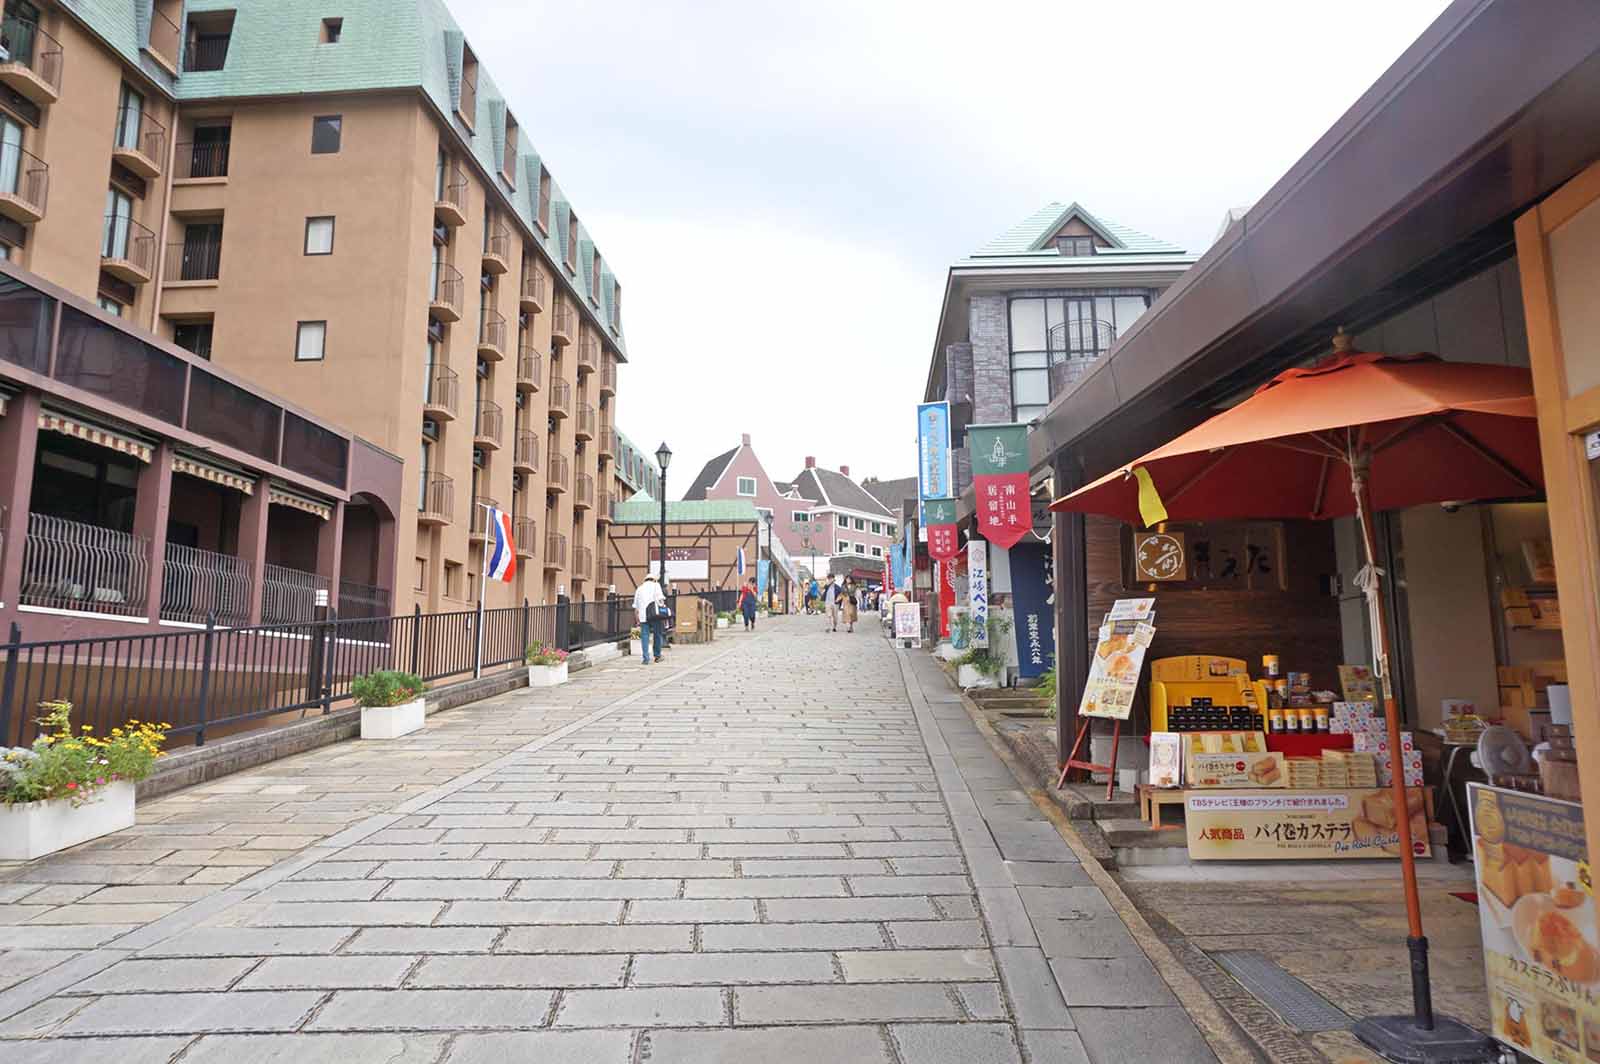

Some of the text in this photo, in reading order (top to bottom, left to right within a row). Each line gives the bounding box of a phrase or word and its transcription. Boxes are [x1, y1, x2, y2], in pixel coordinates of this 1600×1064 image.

[987, 485, 1003, 526] 居留地
[1004, 484, 1017, 525] 南山手
[1199, 827, 1245, 841] 人気商品
